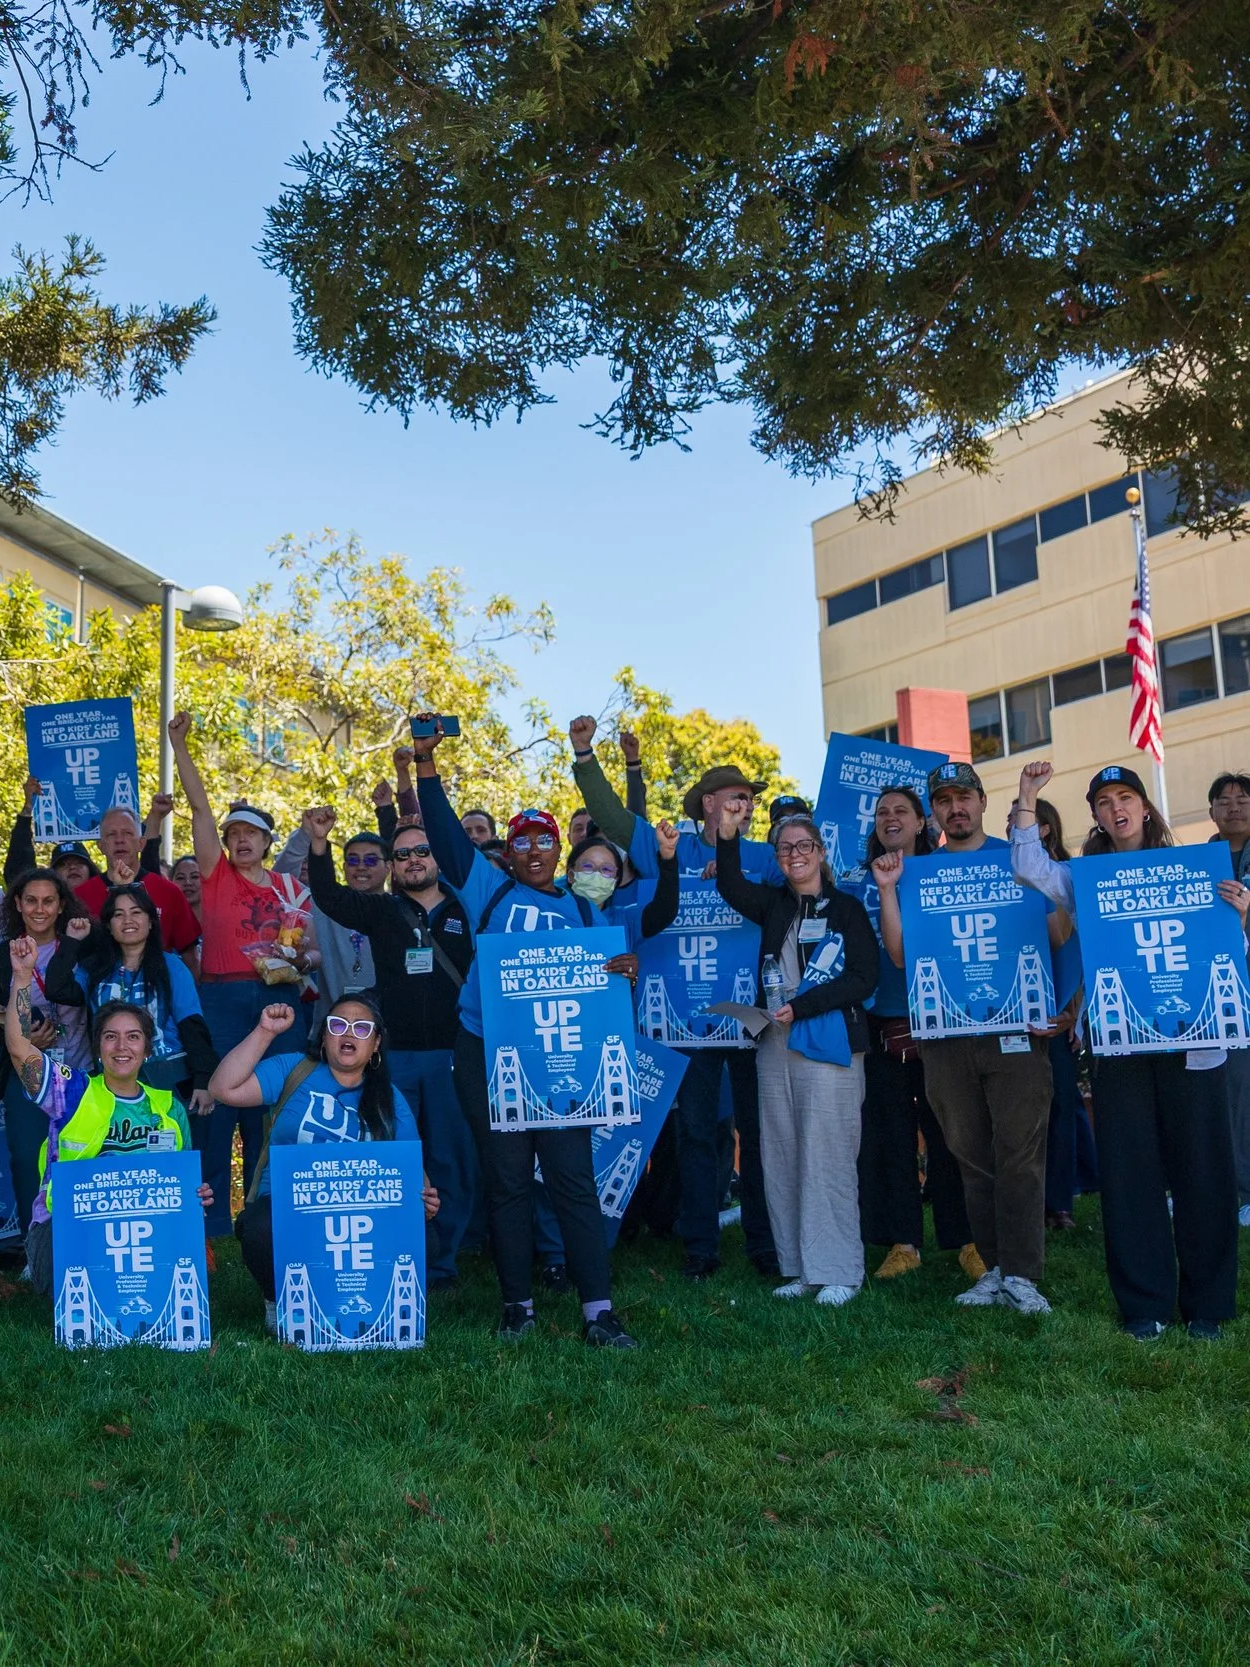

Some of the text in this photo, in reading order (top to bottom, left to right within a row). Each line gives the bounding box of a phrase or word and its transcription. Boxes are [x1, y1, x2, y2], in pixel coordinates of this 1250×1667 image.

[41, 727, 65, 736] KEEP
[68, 724, 92, 733] KIDS'
[42, 729, 120, 744] IN OAKLAND
[65, 748, 100, 767] UP
[66, 766, 101, 786] TE
[840, 770, 854, 782] IN
[841, 763, 868, 774] KEEP
[900, 775, 927, 787] CARE
[937, 865, 1002, 877] ONE YEAR.
[1097, 871, 1210, 888] ONE BRIDGE TOO FAR.
[1116, 864, 1188, 880] ONE YEAR.
[920, 883, 986, 896] KEEP KIDS'
[921, 889, 1024, 907] IN OAKLAND
[1097, 882, 1213, 901] KEEP KIDS' CARE
[1099, 892, 1214, 913] IN OAKLAND
[673, 914, 744, 927] OAKLAND
[951, 913, 997, 939] UP
[1134, 919, 1185, 948] UP
[519, 946, 586, 959] ONE YEAR.
[679, 936, 718, 959] UP
[953, 937, 999, 962] TE
[1137, 945, 1190, 973] TE
[500, 969, 533, 979] KEEP
[537, 966, 570, 977] KIDS'
[679, 959, 719, 981] TE
[501, 974, 609, 991] IN OAKLAND
[534, 1000, 580, 1027] UP
[535, 1026, 583, 1053] TE
[293, 1171, 314, 1179] ONE
[316, 1170, 353, 1178] BRIDGE
[312, 1160, 381, 1171] ONE YEAR.
[93, 1169, 161, 1182] ONE YEAR.
[73, 1187, 182, 1202] KEEP KIDS' CARE
[293, 1180, 402, 1192] KEEP KIDS' CARE
[74, 1196, 182, 1214] IN OAKLAND
[294, 1189, 402, 1205] IN OAKLAND
[106, 1221, 153, 1247] UP
[325, 1215, 373, 1243] UP
[106, 1246, 154, 1273] TE
[326, 1243, 374, 1270] TE
